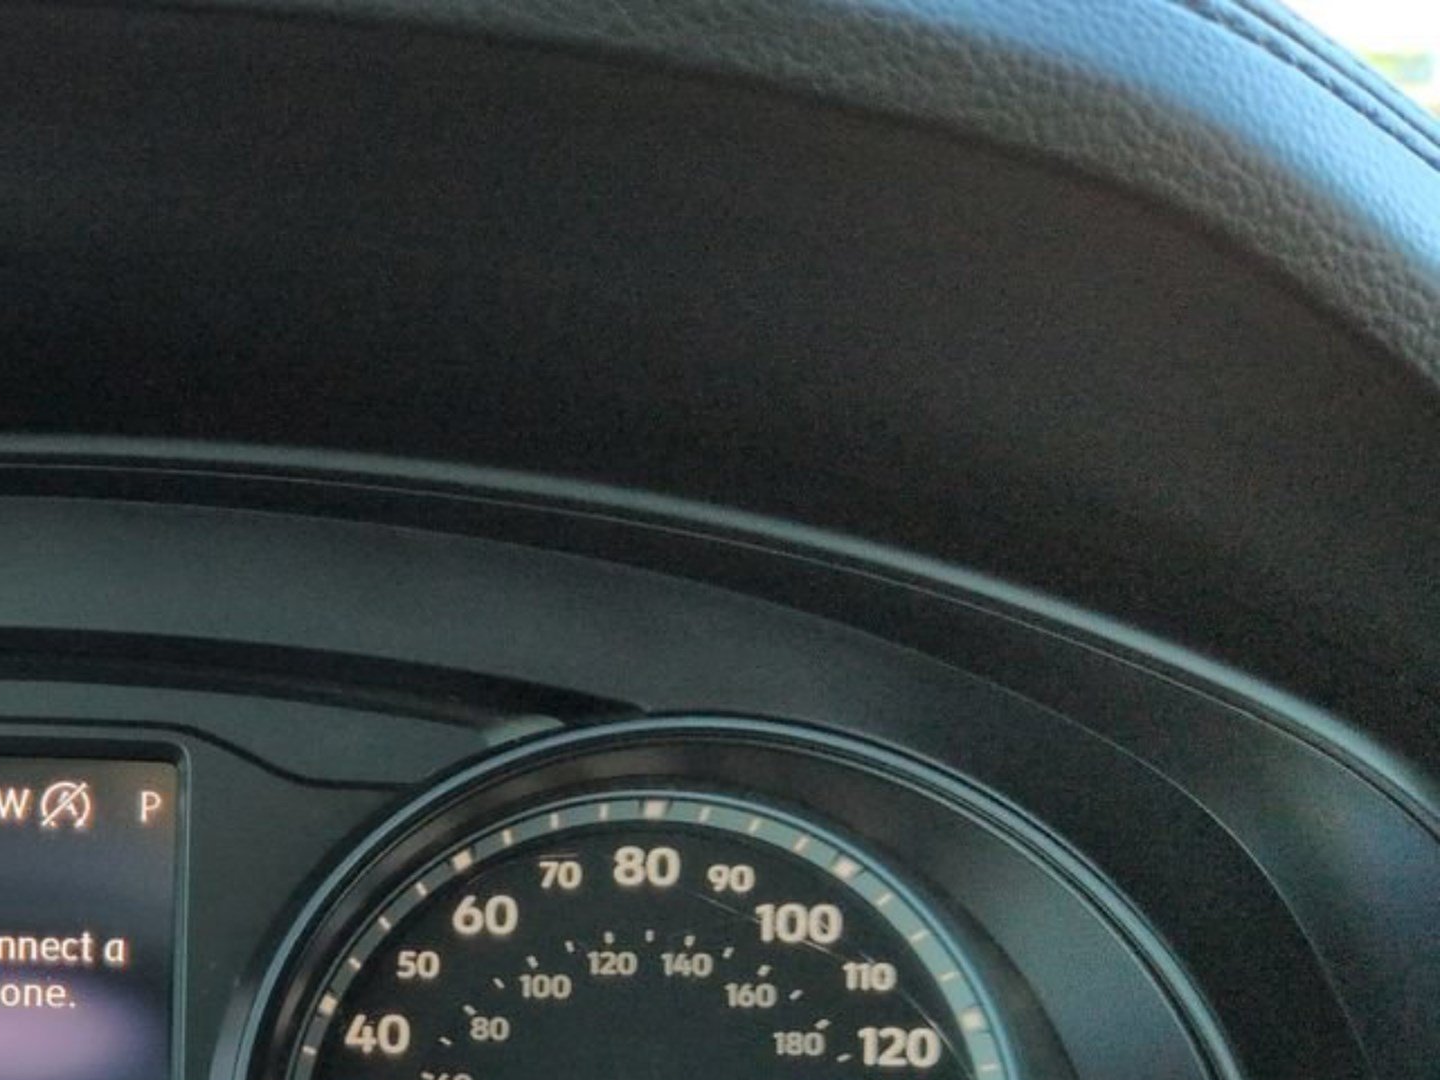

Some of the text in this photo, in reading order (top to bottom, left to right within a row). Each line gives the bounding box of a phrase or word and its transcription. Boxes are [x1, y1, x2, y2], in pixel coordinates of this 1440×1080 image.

[142, 790, 161, 823] P
[539, 860, 583, 888] 70
[613, 846, 681, 886] 80
[707, 864, 756, 893] 90
[452, 895, 519, 936] 60
[755, 903, 844, 944] 100
[105, 938, 127, 964] a
[396, 950, 441, 979] 50
[587, 951, 638, 976] 120
[661, 952, 714, 977] 140
[519, 974, 573, 1000] 100
[842, 961, 898, 992] 110
[724, 983, 779, 1008] 160
[344, 1013, 411, 1053] 40
[469, 1016, 510, 1042] 80
[773, 1031, 826, 1057] 180
[857, 1027, 942, 1068] 120
